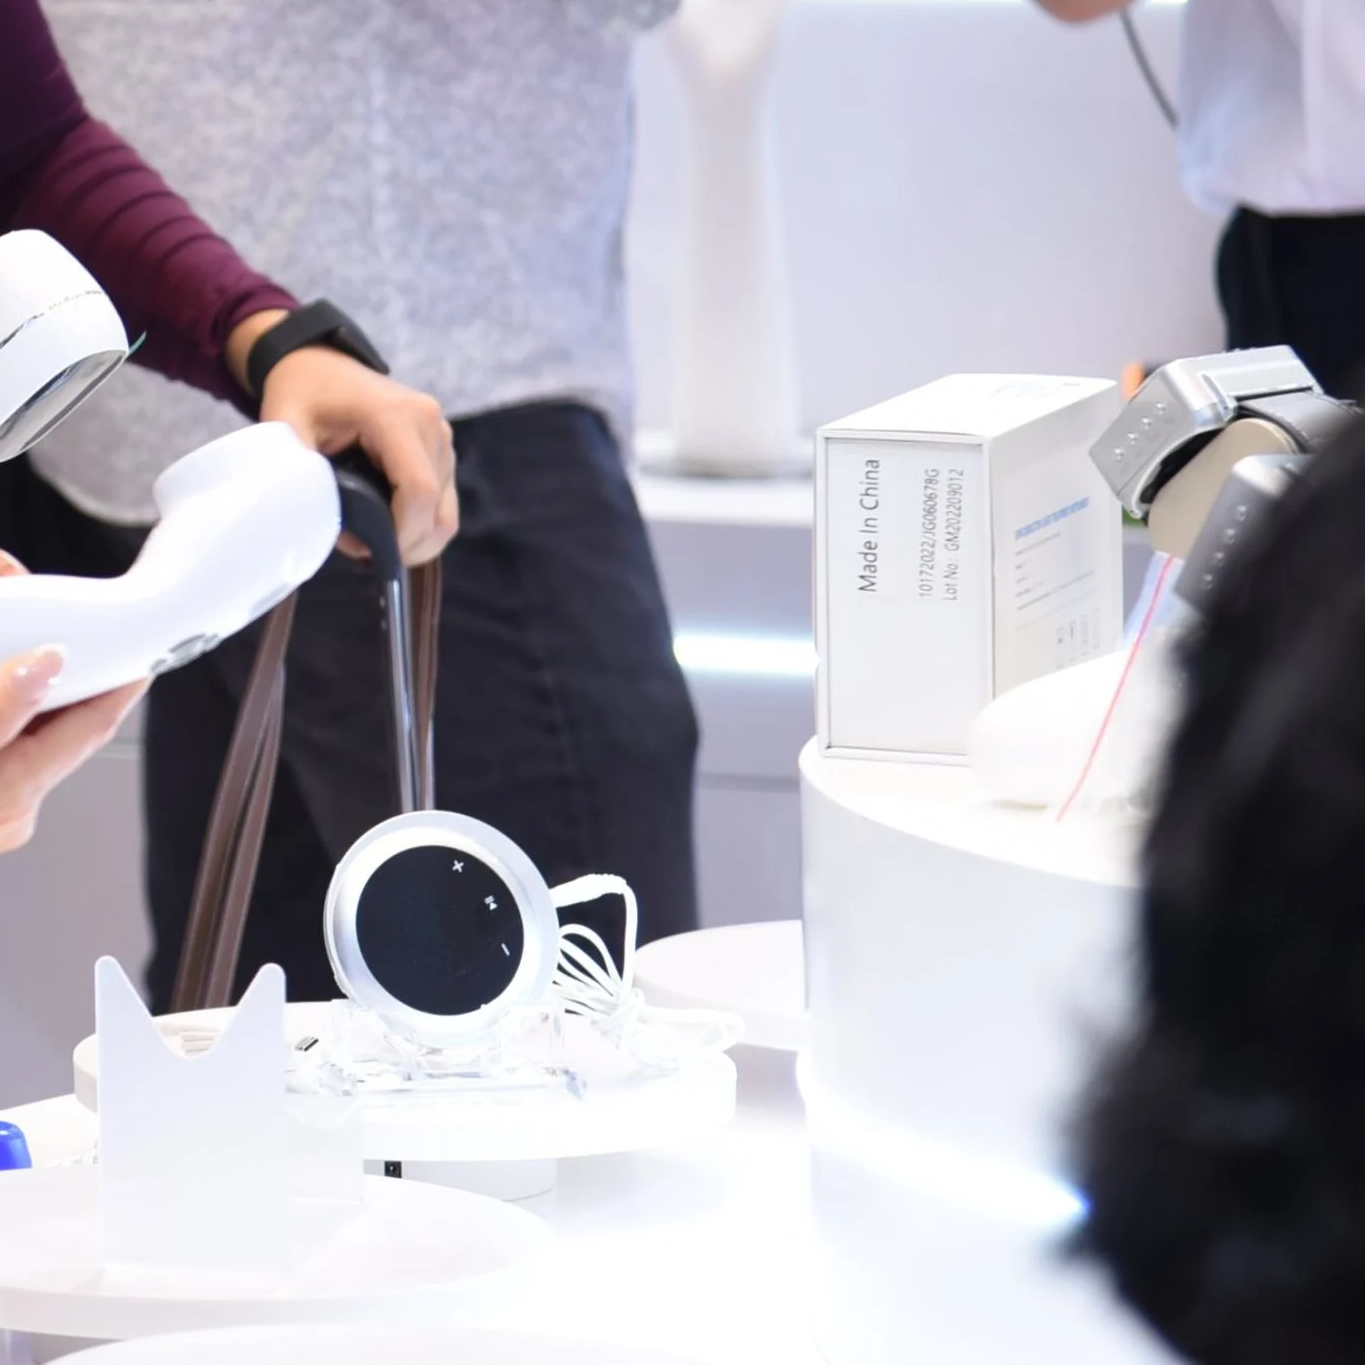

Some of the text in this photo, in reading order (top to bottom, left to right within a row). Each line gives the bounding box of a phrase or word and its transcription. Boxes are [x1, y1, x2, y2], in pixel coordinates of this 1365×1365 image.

[857, 459, 880, 592] Made In China
[944, 468, 964, 552] GM202209012
[942, 583, 958, 601] Lot
